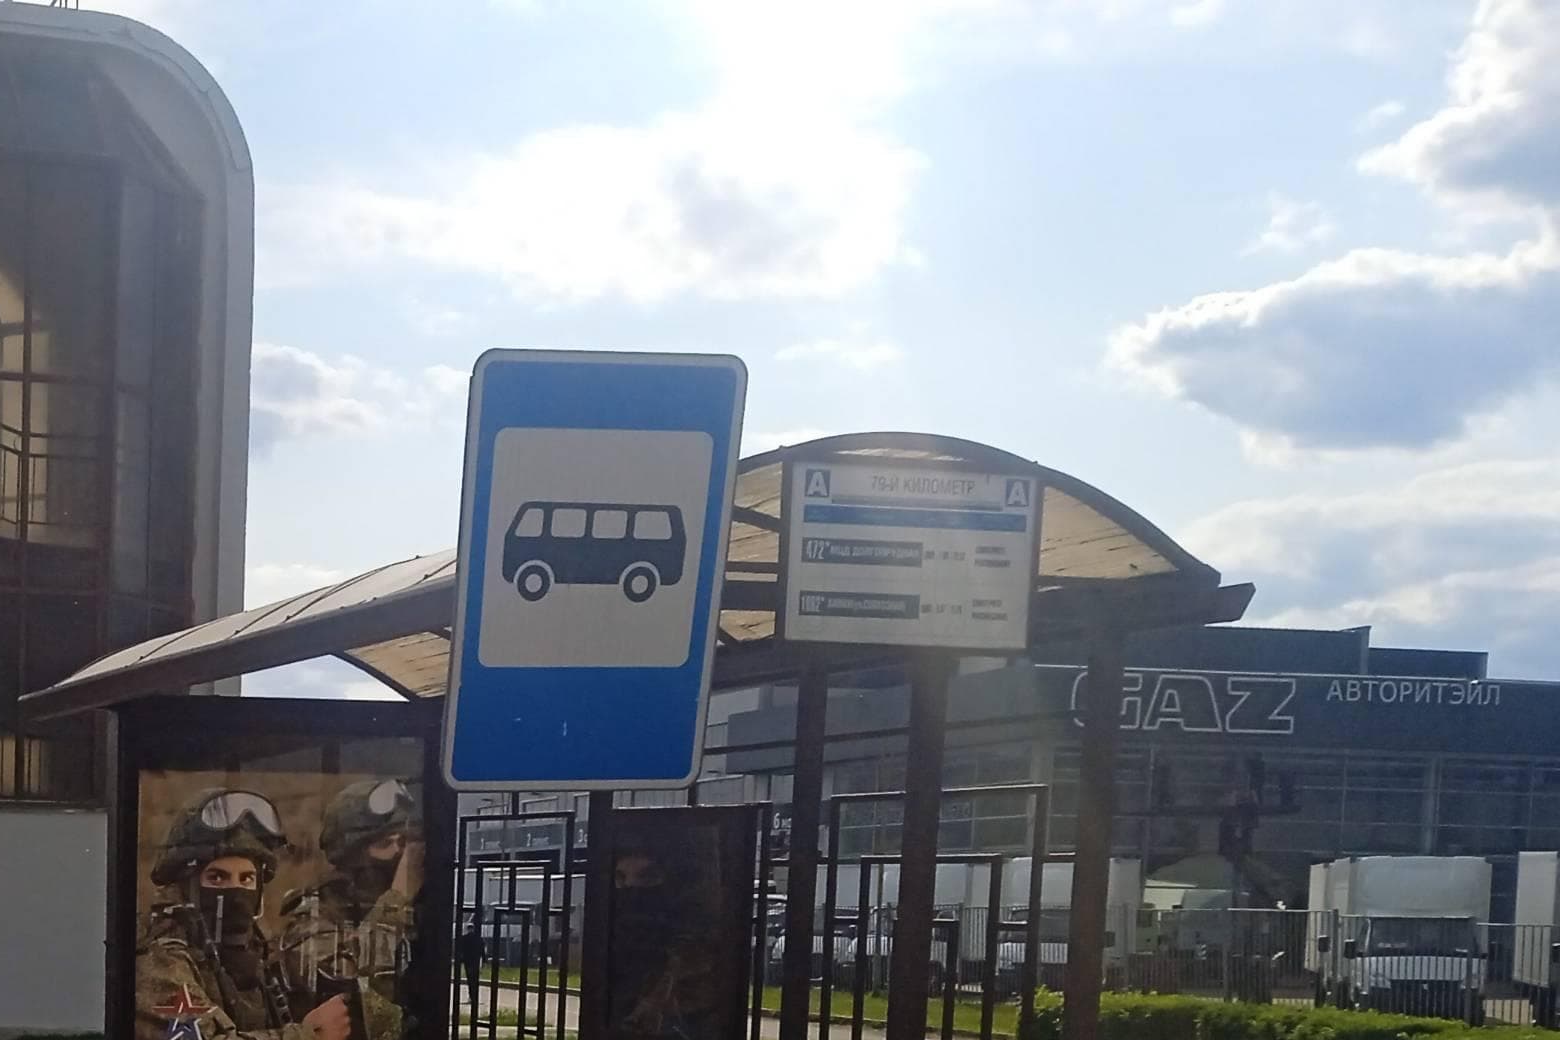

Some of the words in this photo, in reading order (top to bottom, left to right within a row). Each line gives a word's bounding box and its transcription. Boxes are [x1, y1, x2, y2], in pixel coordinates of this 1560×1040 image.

[807, 470, 828, 497] А
[903, 476, 976, 496] КИЛОМЕТР
[1007, 480, 1028, 507] А
[1326, 678, 1502, 706] АВТОРИТЭЙЛ
